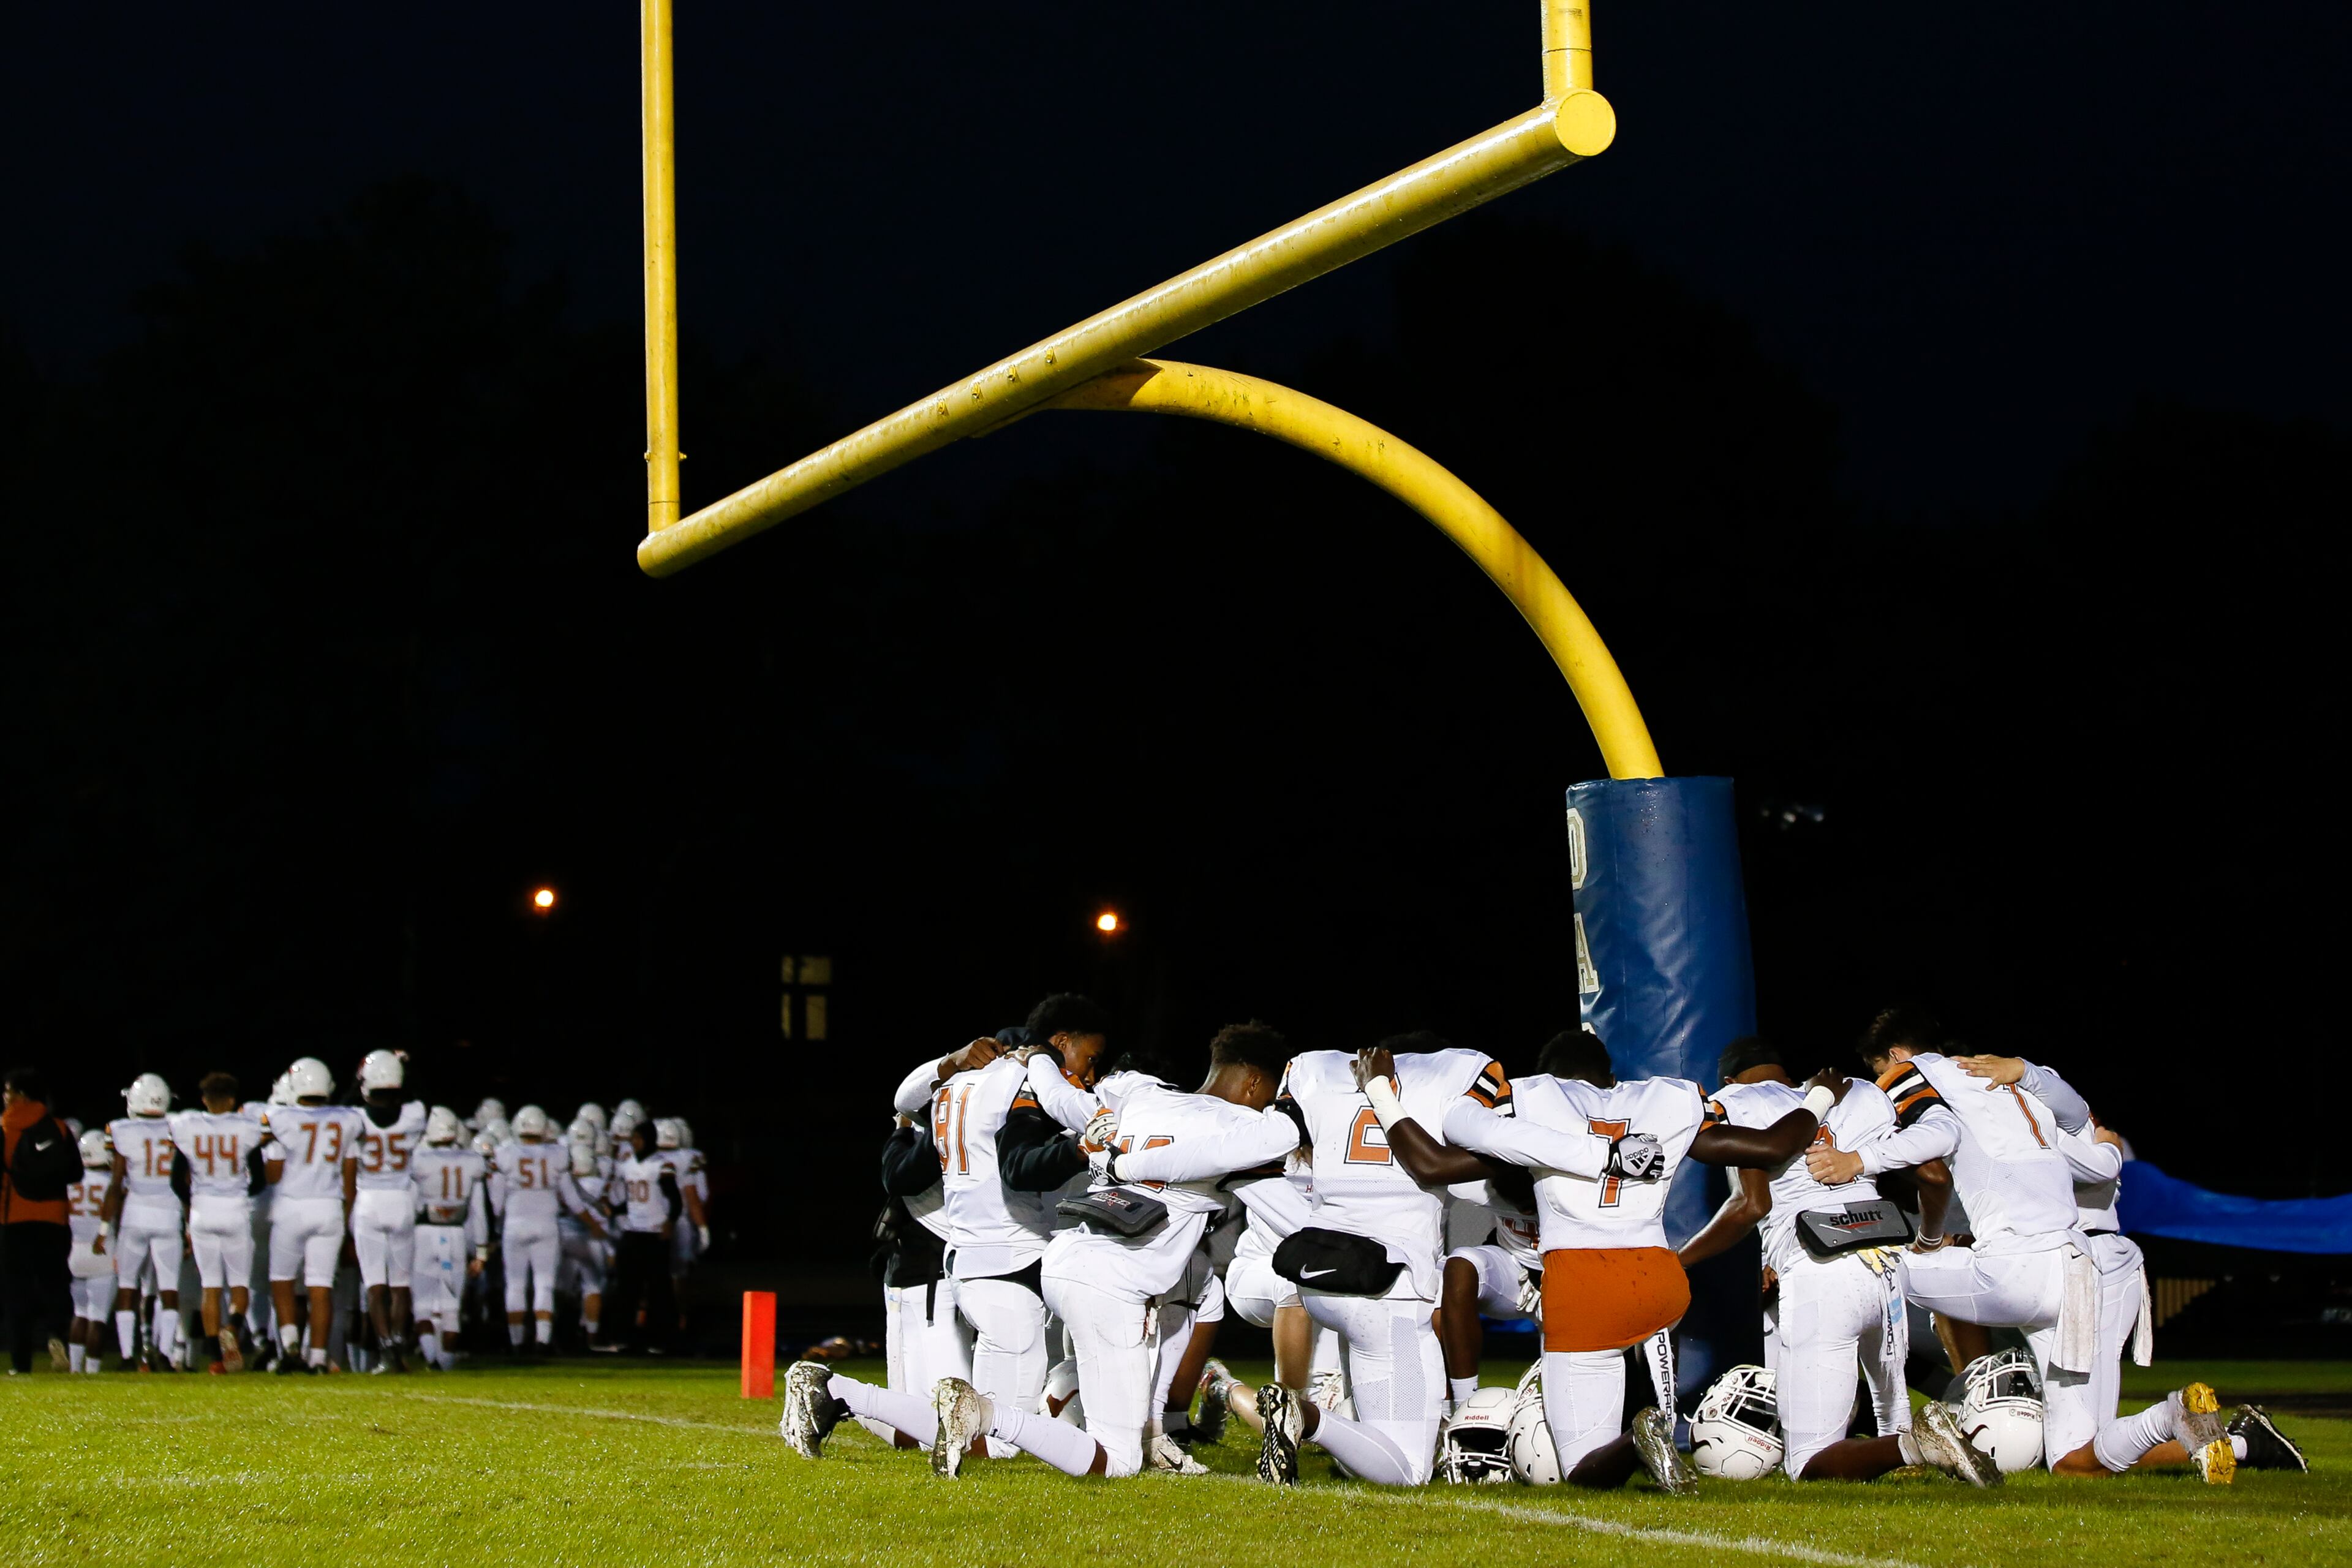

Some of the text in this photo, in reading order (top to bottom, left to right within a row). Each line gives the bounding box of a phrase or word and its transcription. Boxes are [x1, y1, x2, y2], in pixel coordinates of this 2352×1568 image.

[144, 1137, 176, 1177] 12
[194, 1134, 238, 1176] 44
[300, 1121, 342, 1164] 73
[364, 1133, 408, 1172] 35
[1624, 1147, 1649, 1161] adidas
[519, 1157, 549, 1189] 51
[1586, 1114, 1631, 1208] 7
[69, 1182, 104, 1216] 25
[442, 1166, 463, 1200] 11
[1747, 1436, 1772, 1451] Riddell
